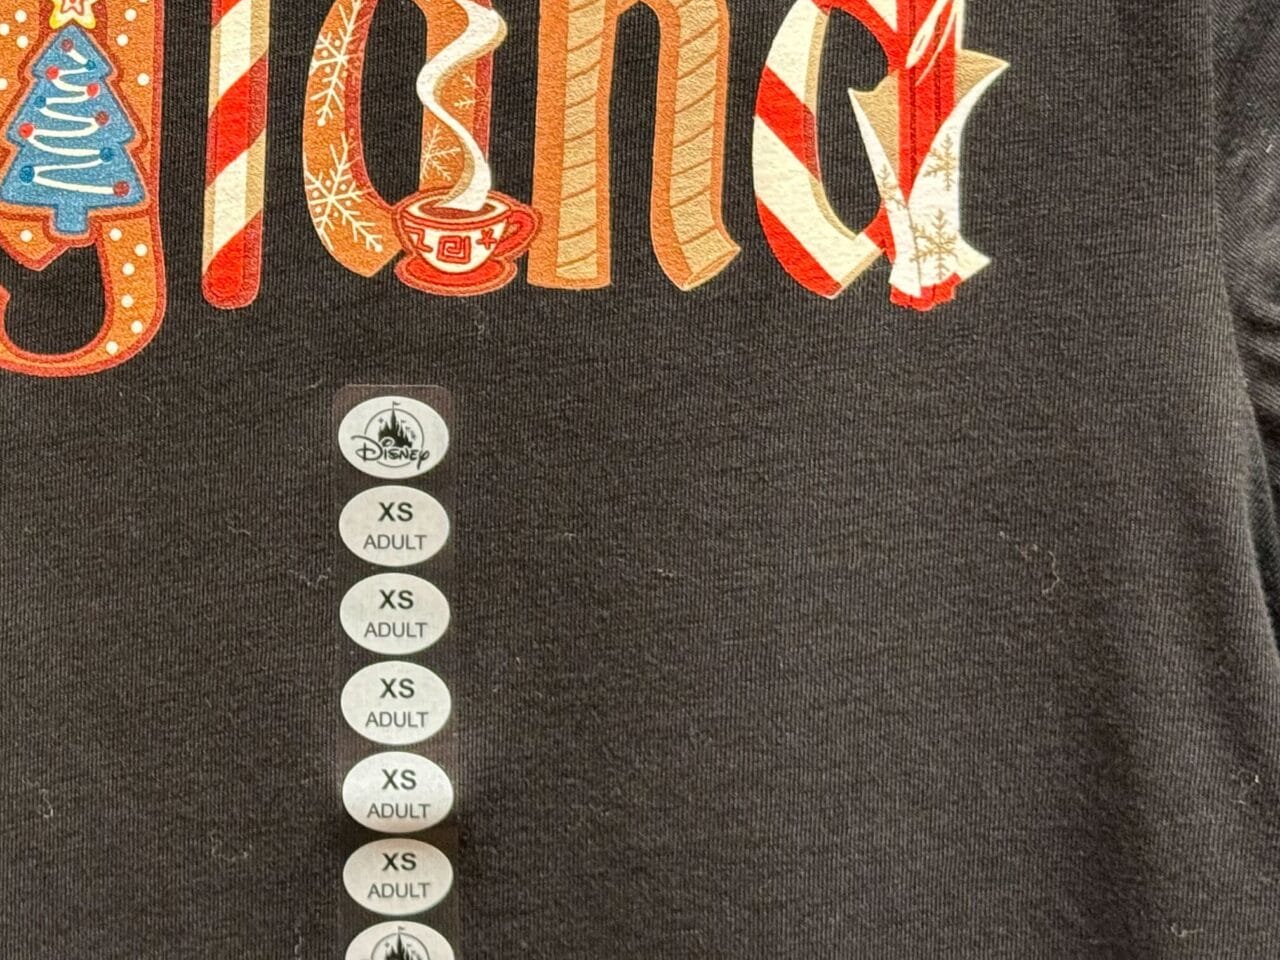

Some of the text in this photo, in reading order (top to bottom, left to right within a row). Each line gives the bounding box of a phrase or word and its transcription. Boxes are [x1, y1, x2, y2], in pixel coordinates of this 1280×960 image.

[378, 502, 414, 522] XS
[363, 534, 428, 550] ADULT
[379, 589, 415, 610] XS
[364, 622, 429, 638] ADULT
[379, 678, 416, 699] XS
[365, 711, 429, 728] ADULT
[381, 769, 418, 791] XS
[367, 803, 431, 819] ADULT
[382, 852, 417, 872] XS
[367, 883, 431, 899] ADULT
